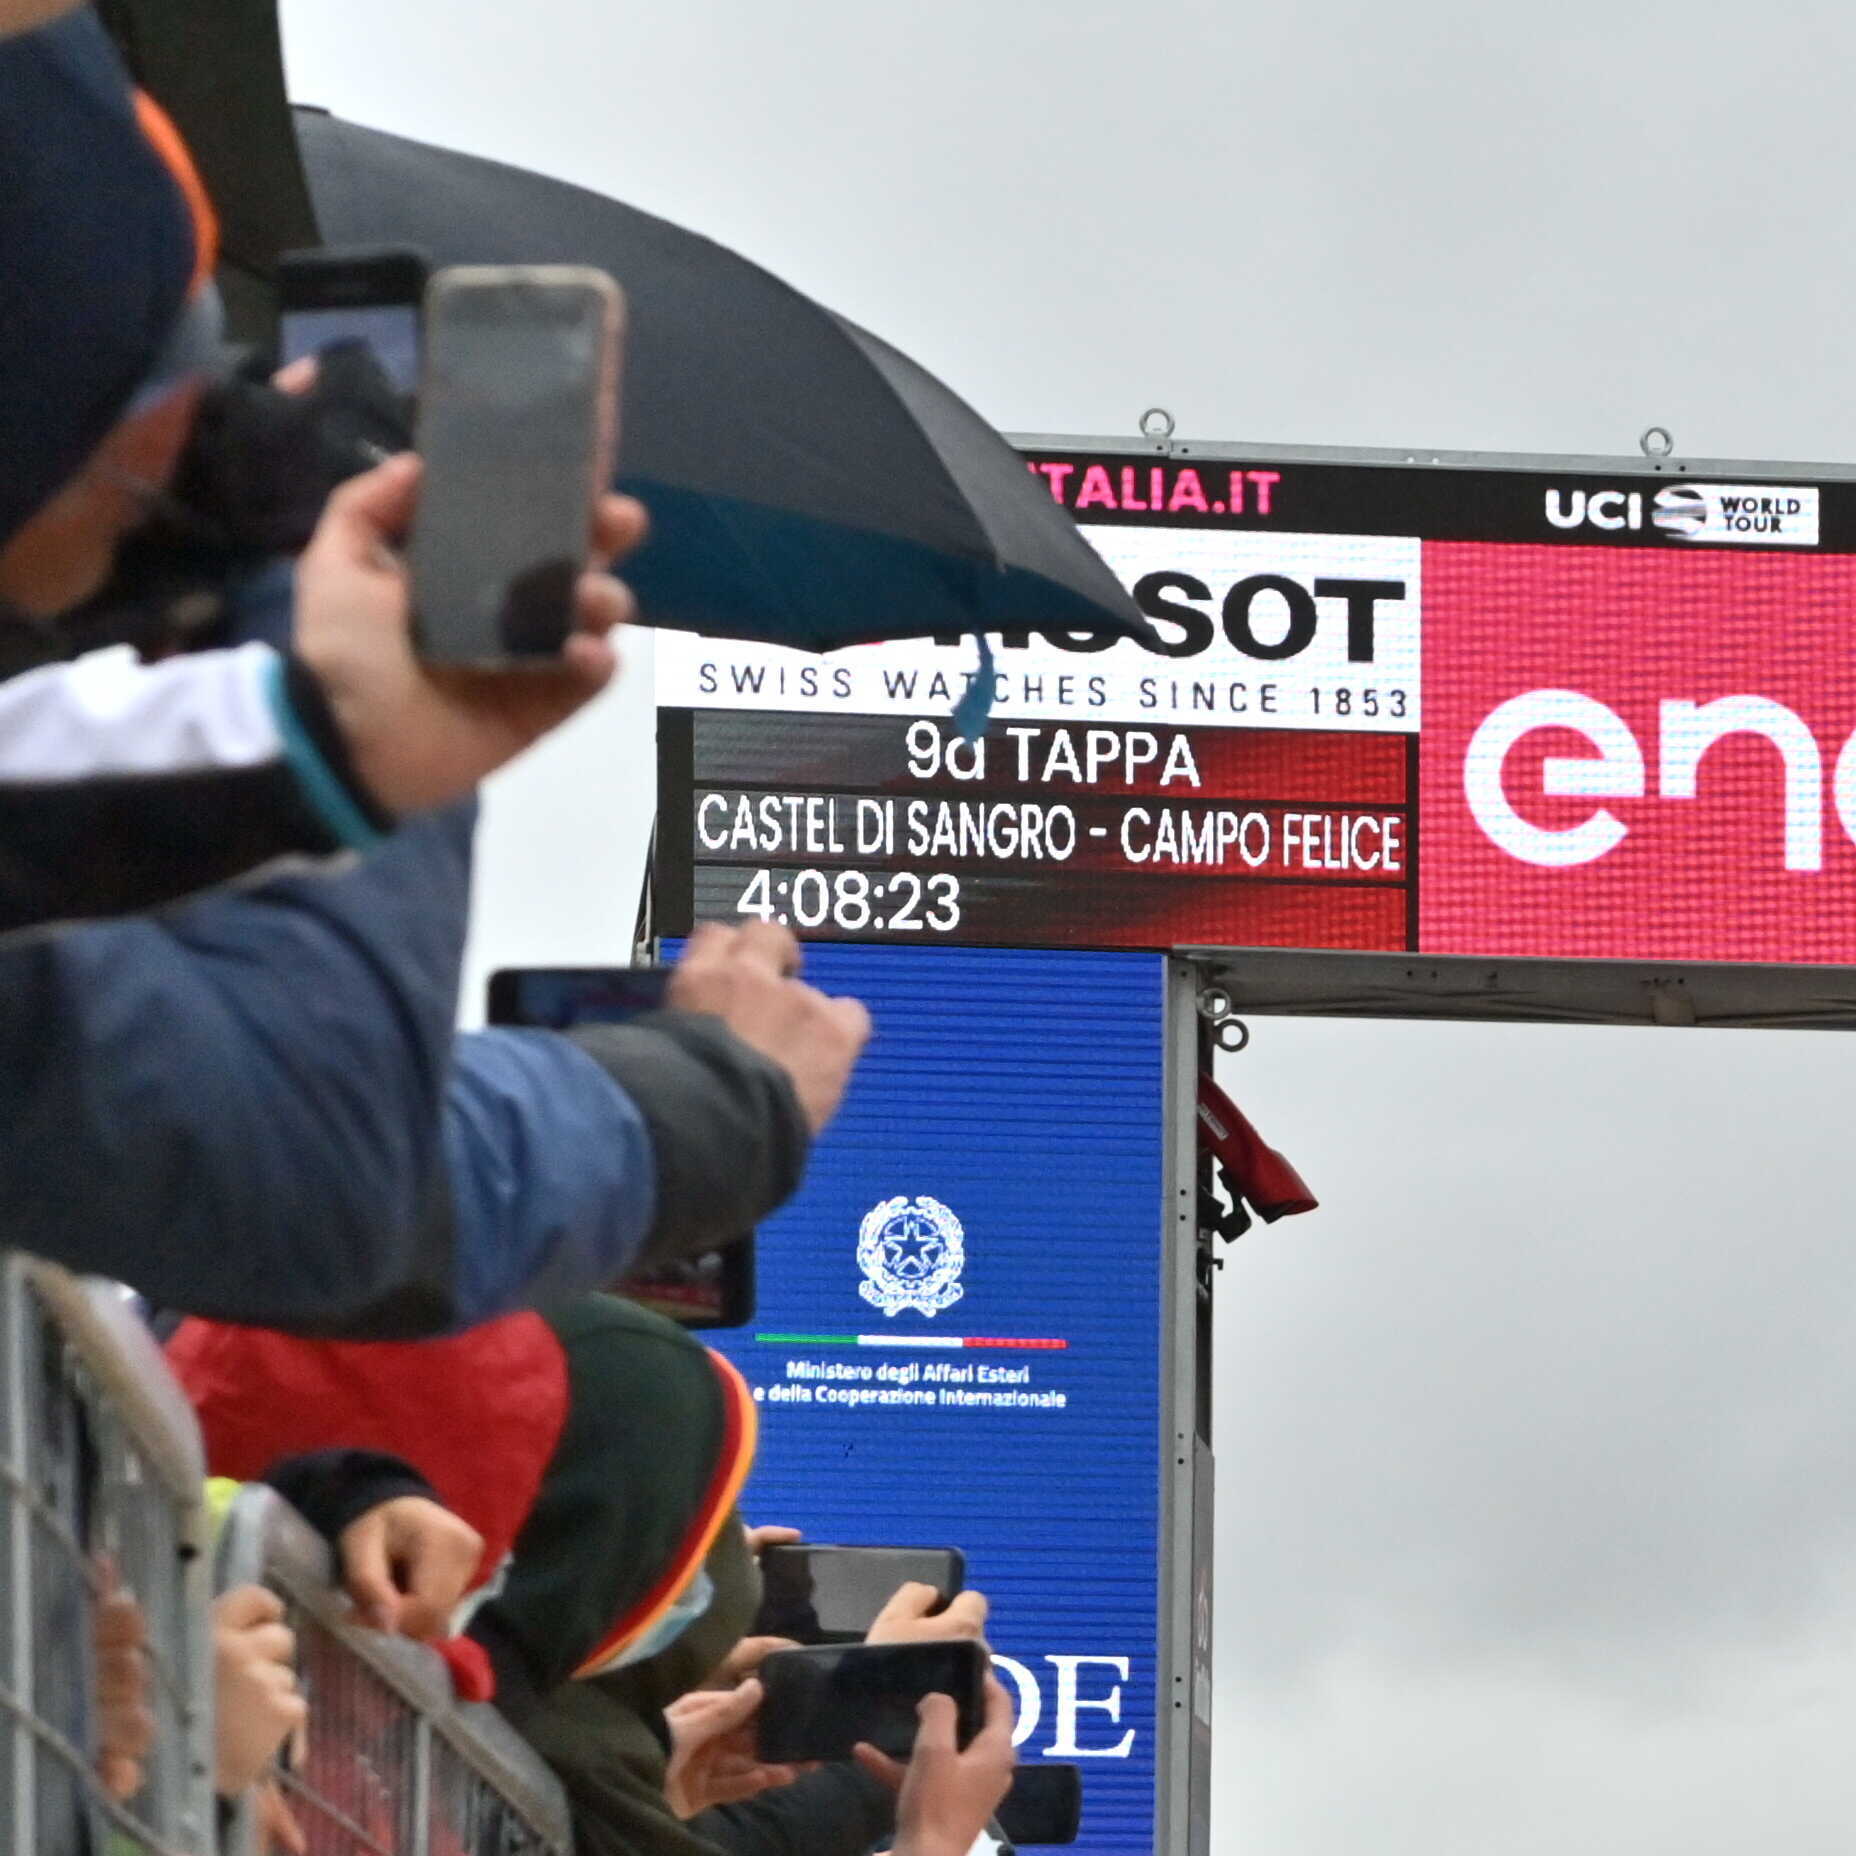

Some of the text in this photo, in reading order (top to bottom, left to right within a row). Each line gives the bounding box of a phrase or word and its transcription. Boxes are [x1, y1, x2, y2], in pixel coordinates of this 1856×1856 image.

[1027, 461, 1282, 515] TALIA.IT
[1545, 488, 1643, 531] UCI
[1720, 498, 1801, 519] WORLD
[1724, 515, 1783, 533] TOUR
[699, 663, 852, 698] SWISS
[1139, 678, 1278, 712] SINCE
[1310, 687, 1407, 718] 1853
[1006, 727, 1202, 787] TAPPA
[697, 793, 845, 855] CASTEL
[857, 798, 894, 857] DI
[908, 802, 1076, 863] SANGRO
[1121, 807, 1270, 869] CAMPO
[1284, 813, 1402, 872] FELICE
[736, 869, 961, 932] 4:08:23
[752, 1384, 1067, 1408] e della Cooperazione Internazionale
[786, 1360, 1031, 1385] Ministero degli Affari Esteri
[990, 1654, 1136, 1758] DE
